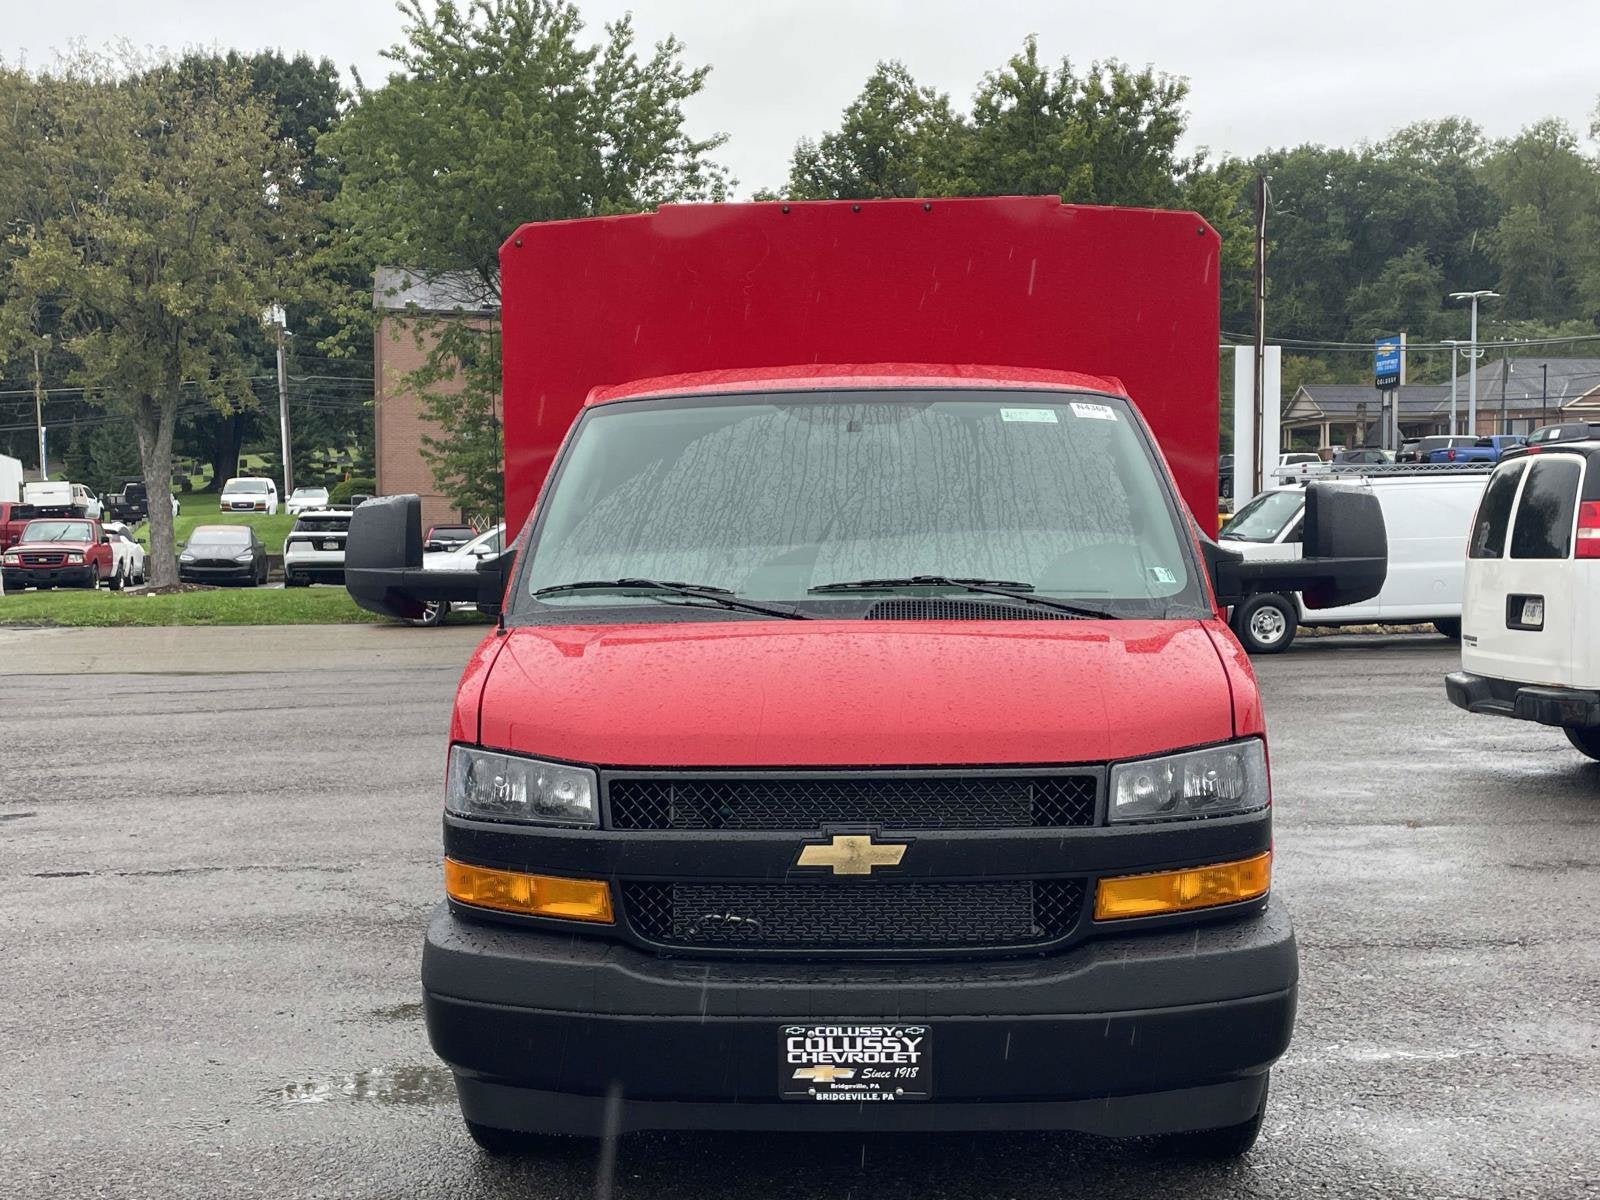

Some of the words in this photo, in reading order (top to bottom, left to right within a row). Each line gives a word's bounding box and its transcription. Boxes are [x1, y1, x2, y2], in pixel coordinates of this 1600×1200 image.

[815, 1027, 895, 1037] COLUSSY
[787, 1037, 923, 1053] COLUSSY
[787, 1052, 921, 1063] CHEVROLET
[861, 1067, 891, 1079] Since
[894, 1067, 919, 1078] 1918
[882, 1093, 895, 1101] PA
